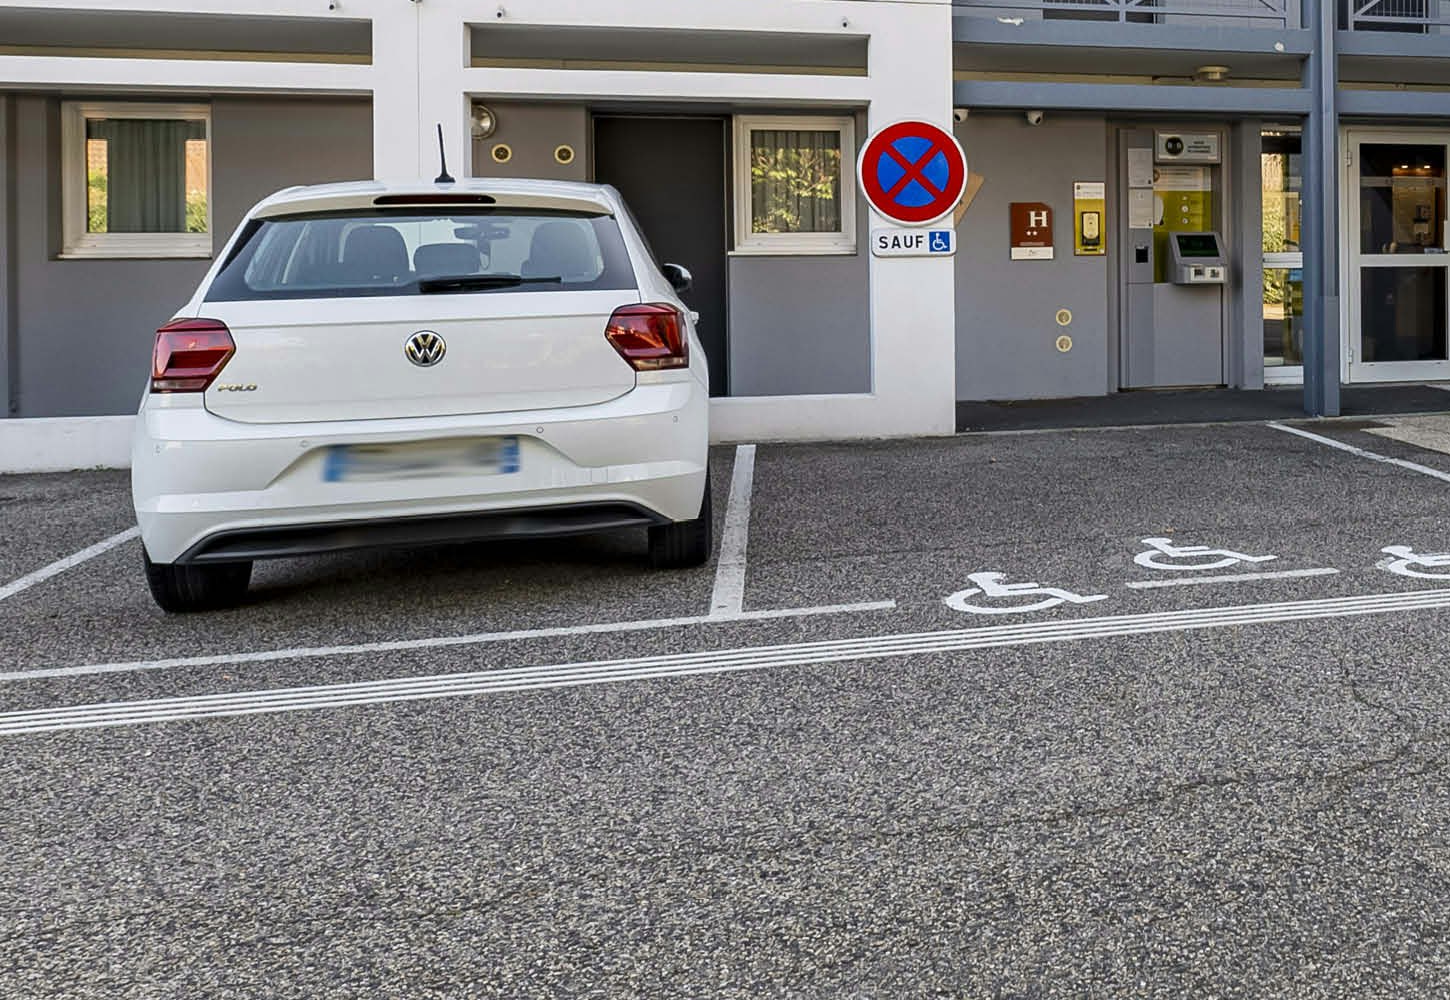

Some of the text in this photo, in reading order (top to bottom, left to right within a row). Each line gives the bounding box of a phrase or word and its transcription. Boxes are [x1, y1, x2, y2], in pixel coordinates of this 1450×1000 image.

[1029, 210, 1048, 228] H
[878, 235, 924, 249] SAUF
[217, 383, 258, 392] POLO
